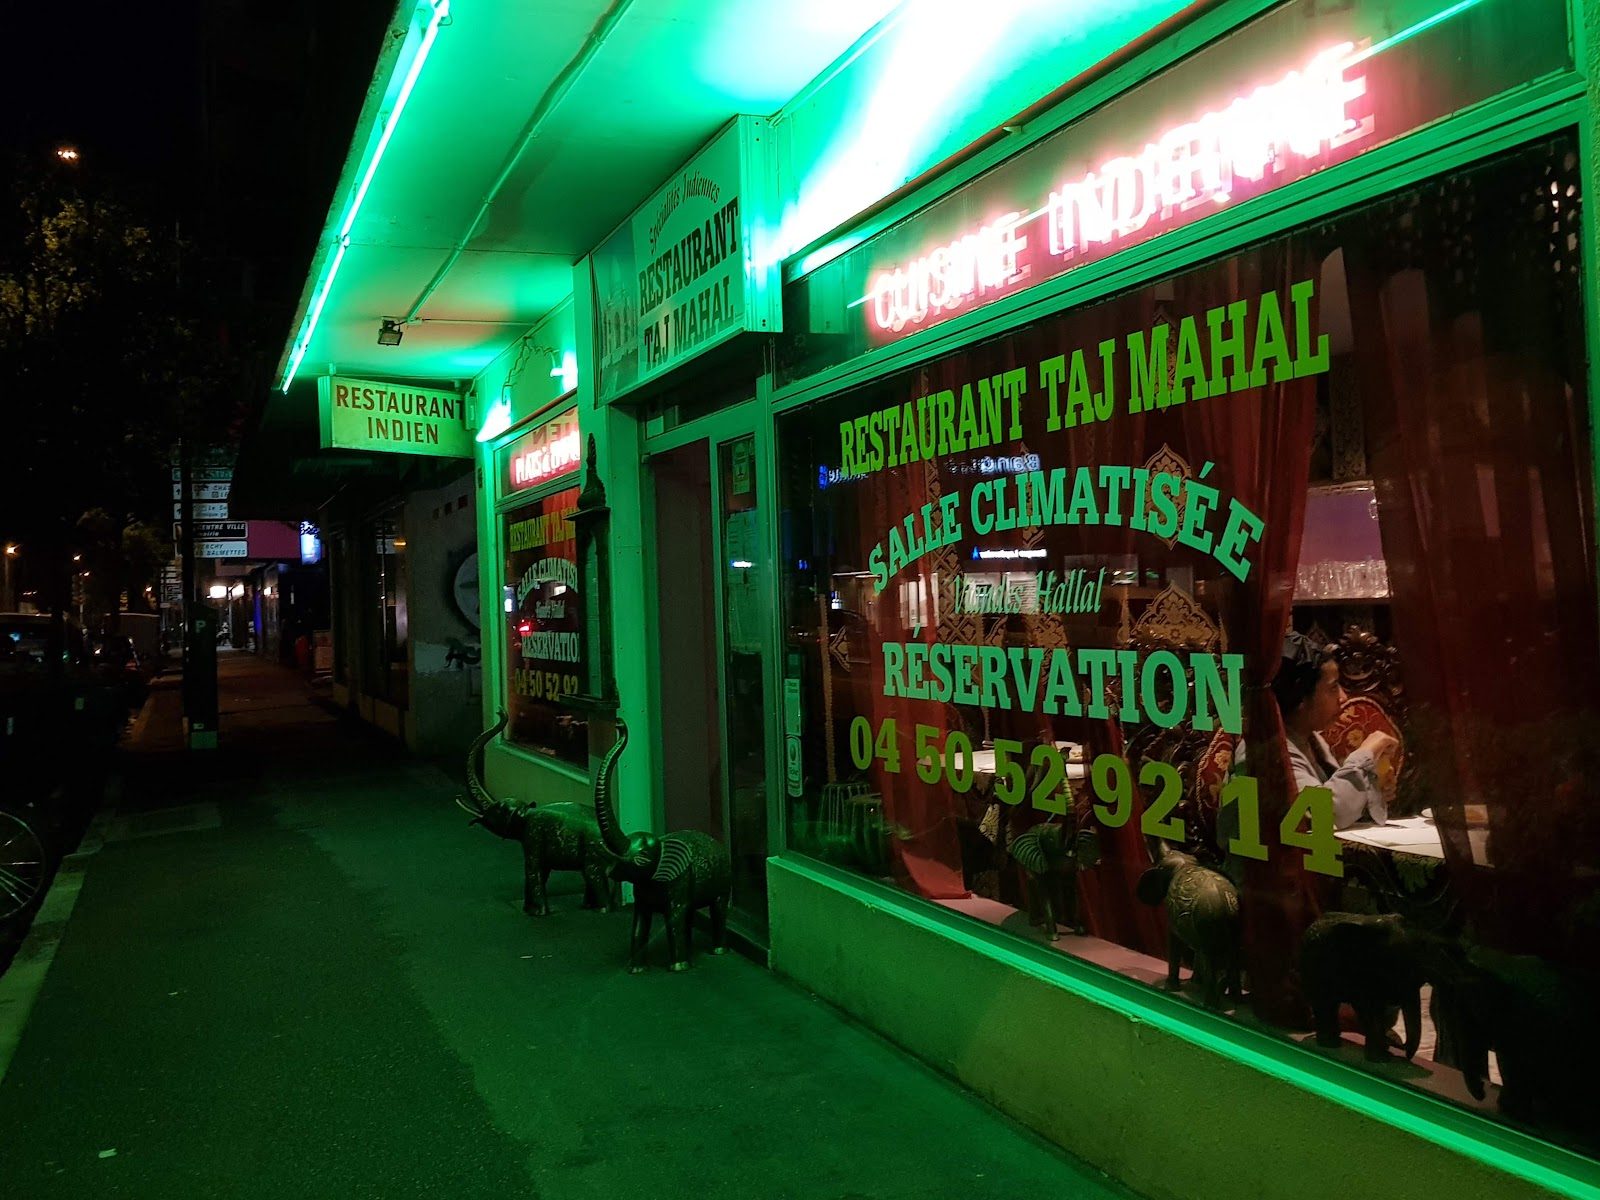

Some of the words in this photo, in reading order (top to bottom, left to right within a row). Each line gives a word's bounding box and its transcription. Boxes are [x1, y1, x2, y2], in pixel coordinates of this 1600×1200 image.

[682, 171, 721, 204] Indiennes
[870, 211, 1030, 332] CUISINE
[1047, 41, 1374, 258] INDIENNE
[638, 196, 738, 316] RESTAURANT
[644, 314, 671, 366] TAJ
[673, 276, 735, 353] MAHAL
[336, 384, 464, 420] RESTAURANT
[839, 367, 1027, 476] RESTAURANT
[1040, 339, 1114, 432] TAJ
[1127, 279, 1331, 415] MAHAL
[367, 416, 439, 444] INDIEN
[868, 491, 963, 596] SALLE
[970, 461, 1265, 584] CLIMATISÉE
[538, 557, 578, 593] CLIMATIS
[1035, 568, 1106, 614] Hallal
[529, 670, 543, 698] 50
[545, 672, 560, 702] 52
[882, 623, 1245, 735] RÉSERVATION
[850, 716, 901, 773] 04
[914, 723, 974, 793] 50
[994, 738, 1067, 816] 52
[1092, 753, 1186, 843] 92
[1221, 775, 1345, 878] 14
